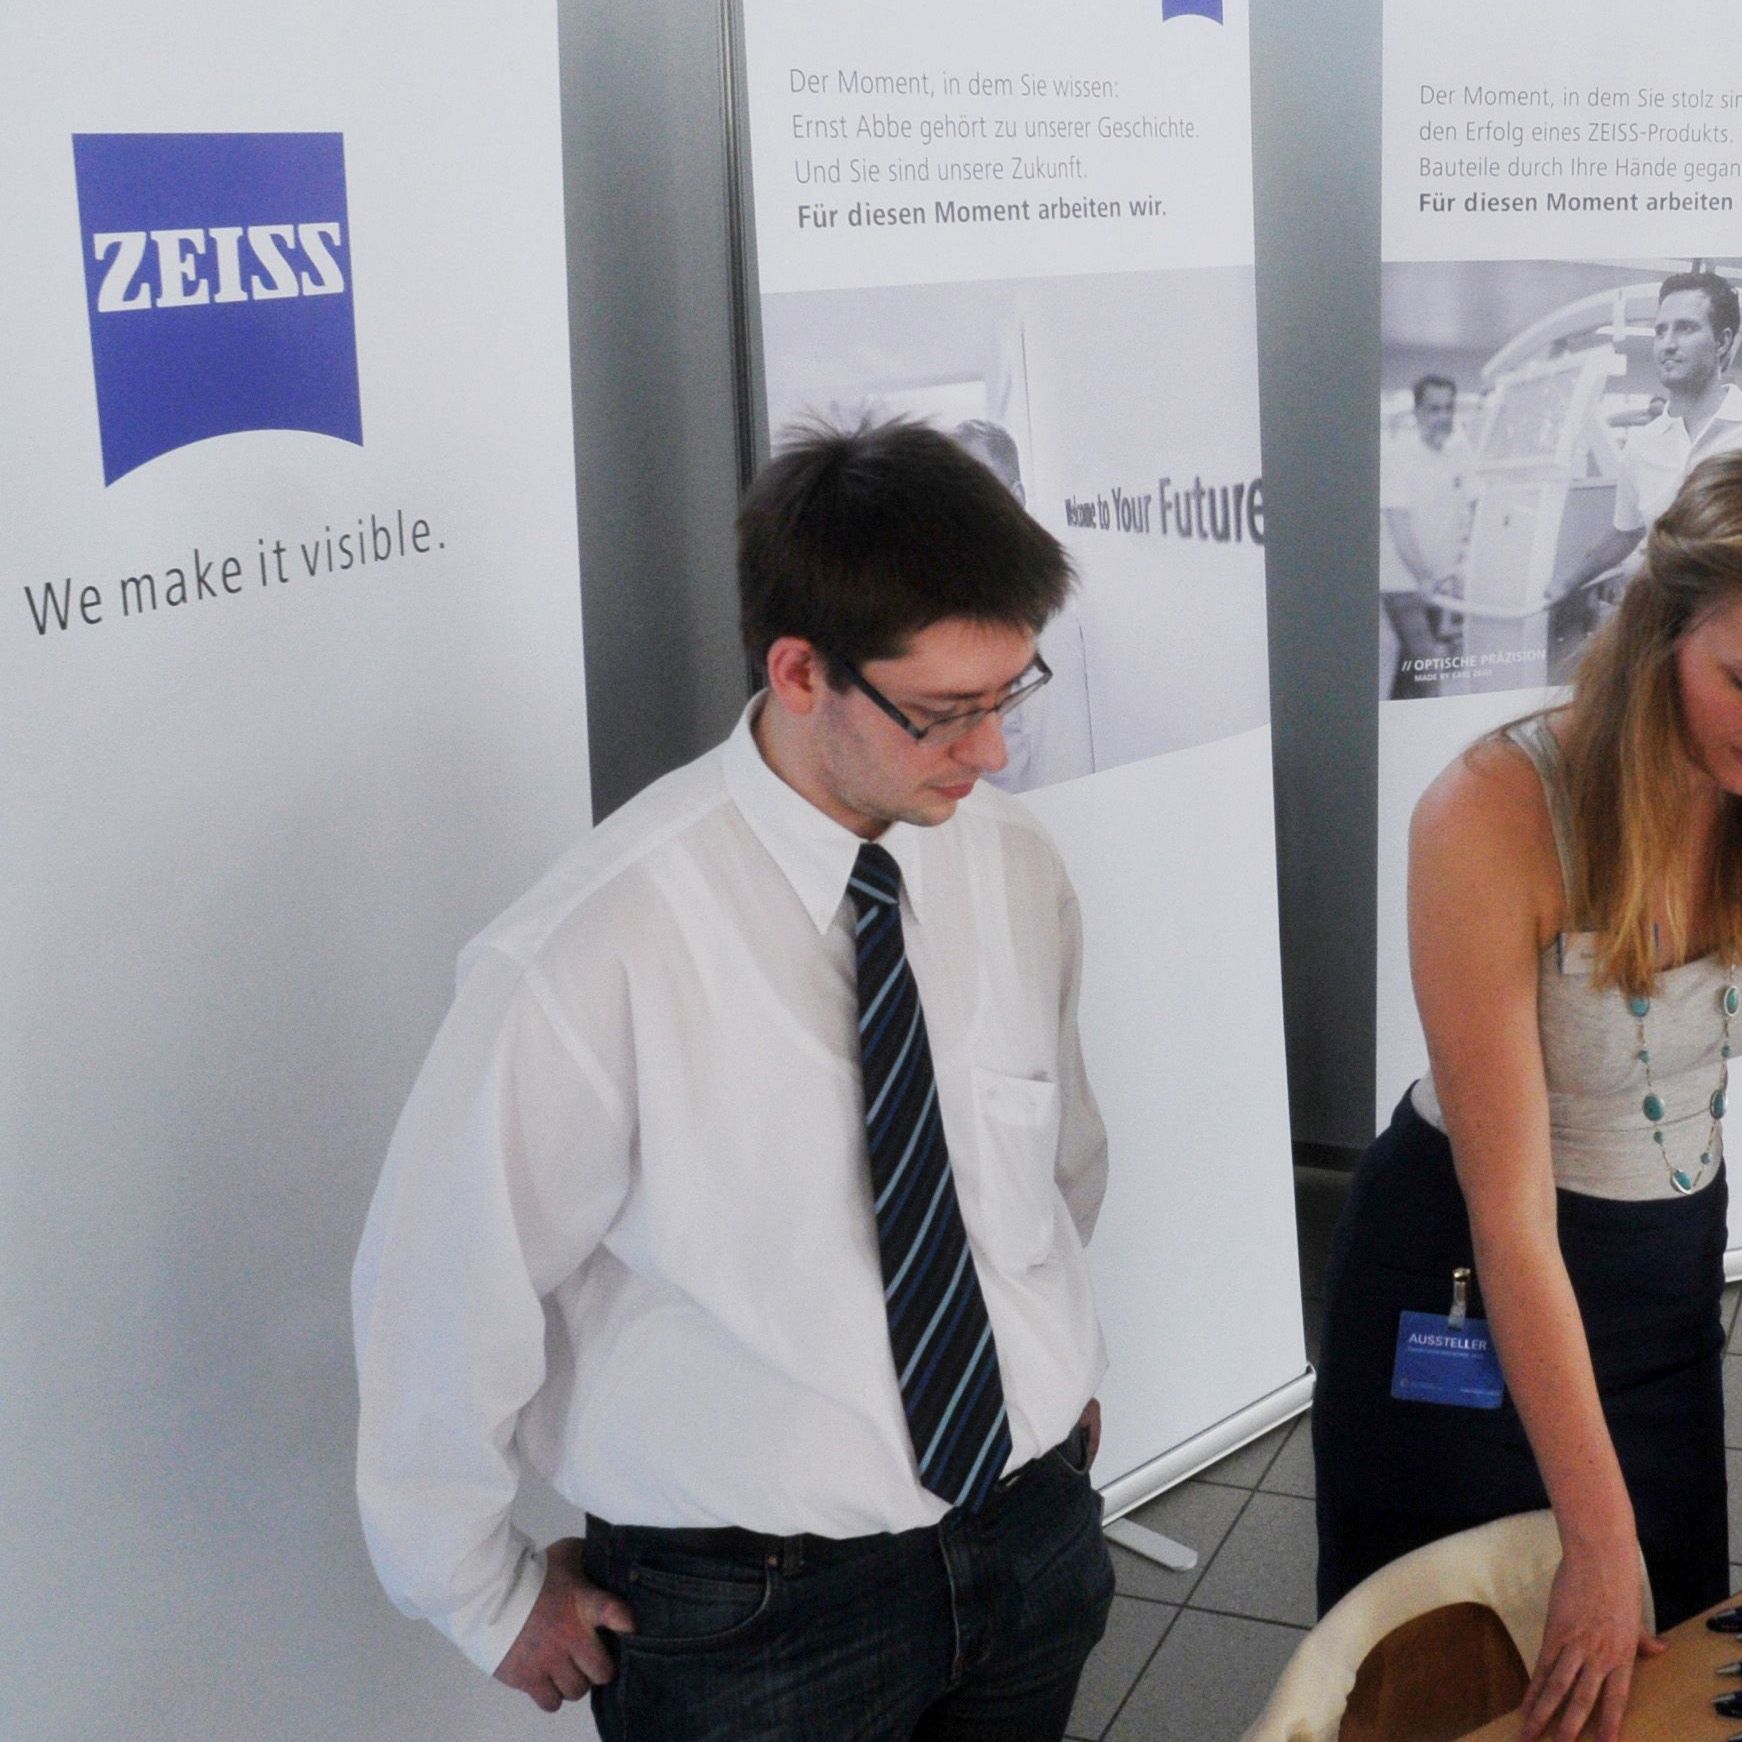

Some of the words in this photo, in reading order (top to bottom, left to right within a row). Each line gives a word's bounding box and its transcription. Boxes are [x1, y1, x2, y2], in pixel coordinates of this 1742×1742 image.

[790, 68, 829, 94] Der
[838, 70, 935, 98] Moment,
[943, 71, 961, 95] in
[968, 72, 1013, 96] dem
[1021, 73, 1047, 96] Sie
[1053, 75, 1119, 98] wissen:
[1420, 84, 1455, 106] Der
[1464, 85, 1554, 109] Moment,
[1563, 86, 1579, 107] in
[1587, 87, 1630, 107] dem
[1638, 88, 1664, 108] Sie
[1671, 89, 1713, 109] stolz
[792, 114, 848, 139] Ernst
[856, 113, 912, 139] Abbe
[920, 113, 987, 145] gehört
[994, 120, 1017, 139] zu
[1025, 120, 1091, 139] unserer
[1098, 116, 1200, 139] Geschichte.
[1419, 120, 1457, 141] den
[1466, 119, 1524, 147] Erfolg
[1532, 122, 1581, 142] eines
[1588, 122, 1733, 144] ZEISS-Produkts.
[795, 158, 841, 184] Und
[850, 158, 880, 183] Sie
[888, 156, 930, 182] sind
[937, 161, 1004, 181] unsere
[1011, 155, 1088, 180] Zukunft.
[1419, 156, 1500, 177] Bauteile
[1508, 156, 1563, 177] durch
[1571, 156, 1608, 177] Ihre
[1616, 157, 1677, 177] Hände
[798, 203, 838, 229] Für
[848, 201, 926, 227] diesen
[935, 200, 1030, 224] Moment
[1038, 196, 1121, 220] arbeiten
[1128, 194, 1166, 216] wir.
[1419, 192, 1456, 212] Für
[1464, 192, 1537, 212] diesen
[1547, 192, 1638, 211] Moment
[1646, 191, 1733, 211] arbeiten
[93, 221, 346, 314] ZEISS
[1064, 495, 1097, 529] Welcome
[1097, 494, 1110, 530] to
[1111, 487, 1151, 534] Your
[1159, 474, 1264, 545] Future
[24, 578, 102, 636] We
[120, 549, 242, 616] make
[258, 538, 289, 587] it
[301, 508, 446, 577] visible.
[1409, 1333, 1487, 1351] AUSSTELLER
